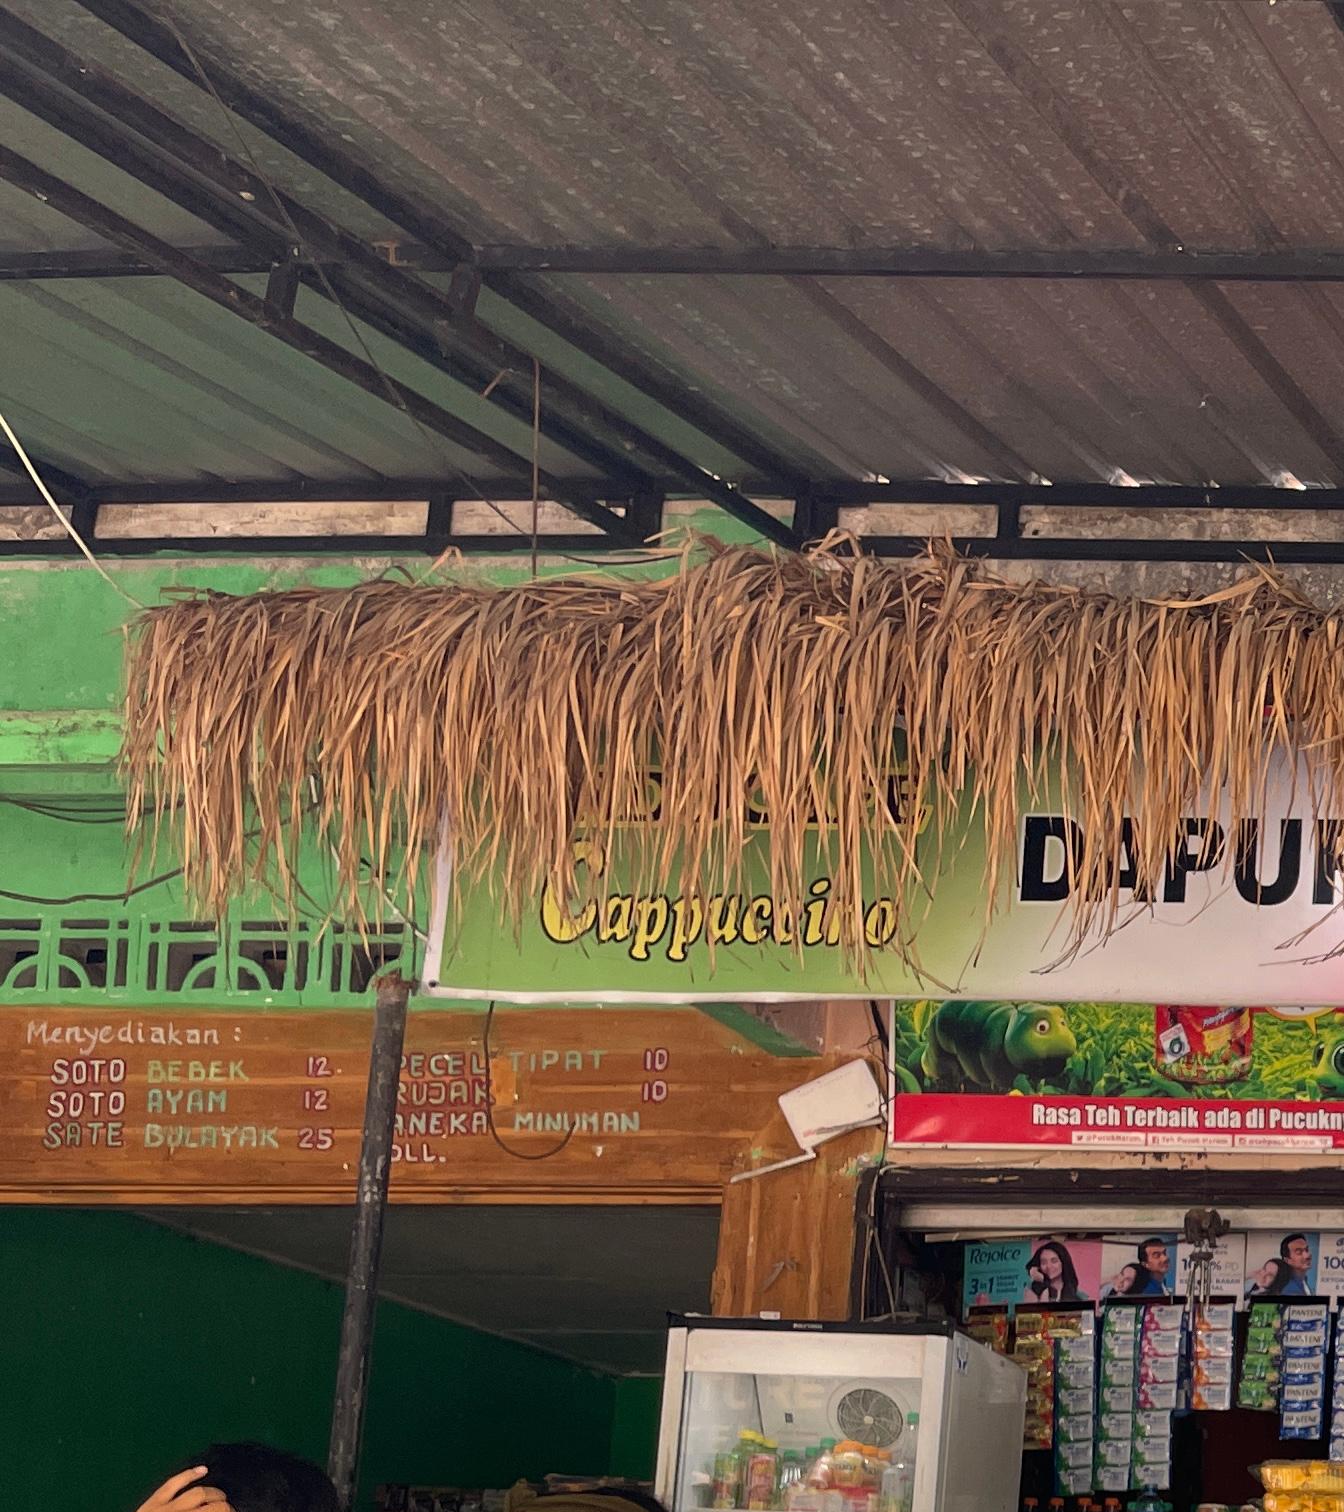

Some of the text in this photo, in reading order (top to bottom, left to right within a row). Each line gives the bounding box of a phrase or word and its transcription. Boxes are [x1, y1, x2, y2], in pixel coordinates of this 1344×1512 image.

[27, 1020, 219, 1055] Menyediakan
[51, 1056, 332, 1085] SOTO BEBEK 12
[508, 1050, 607, 1073] TIPAT
[47, 1088, 331, 1119] SOTO AYAM 12
[1032, 1103, 1081, 1126] Rasa
[1085, 1104, 1120, 1127] Teh
[1124, 1105, 1199, 1129] Terbaik
[1204, 1107, 1241, 1129] ada
[1245, 1107, 1265, 1130] di
[43, 1121, 335, 1153] SATE BULAYAK 25
[514, 1111, 641, 1136] MINUMAN
[969, 1246, 1022, 1268] Rejoice
